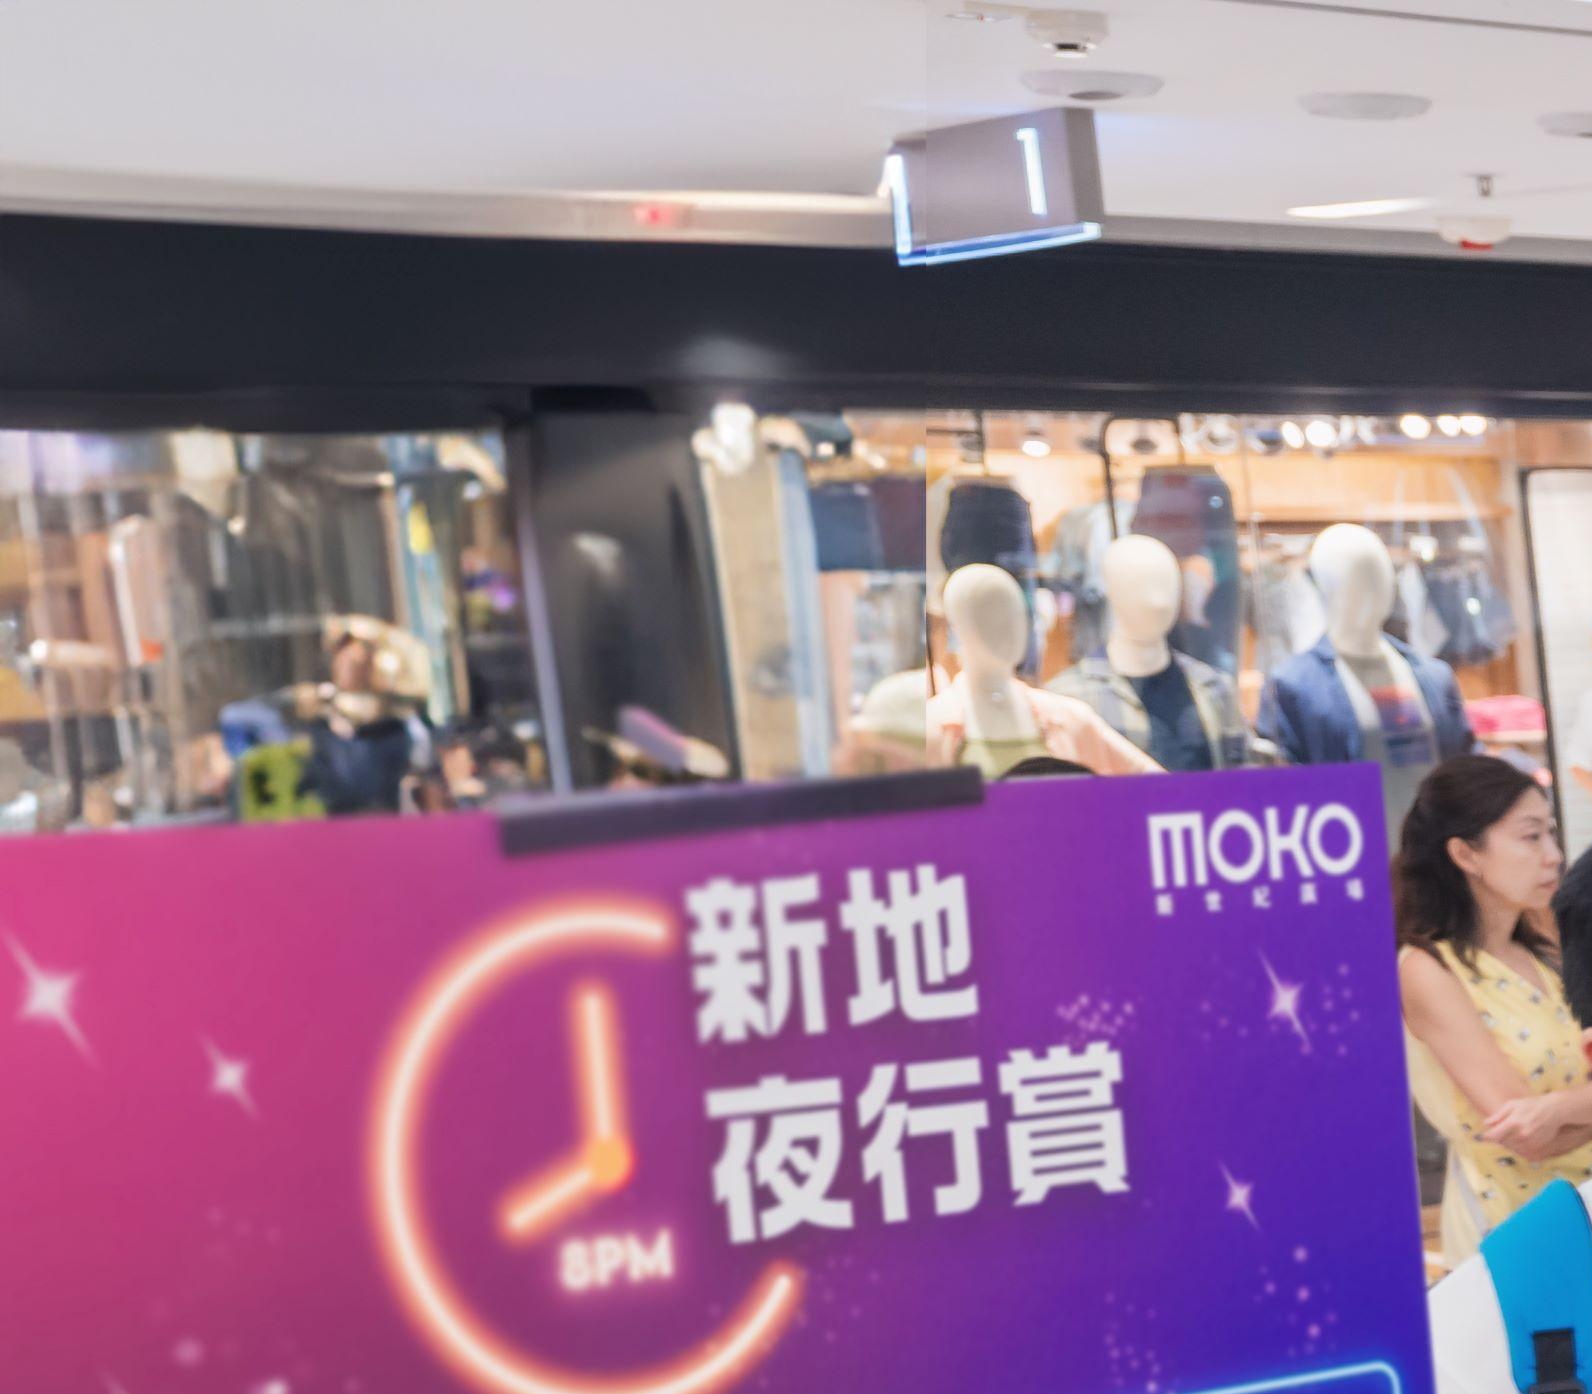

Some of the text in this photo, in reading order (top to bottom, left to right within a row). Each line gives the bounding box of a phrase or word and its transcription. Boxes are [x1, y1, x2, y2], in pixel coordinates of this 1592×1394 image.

[1147, 802, 1363, 889] MOKO
[684, 864, 979, 1044] 新地
[705, 1041, 1131, 1244] 夜行賞
[564, 1230, 673, 1290] 8PM
